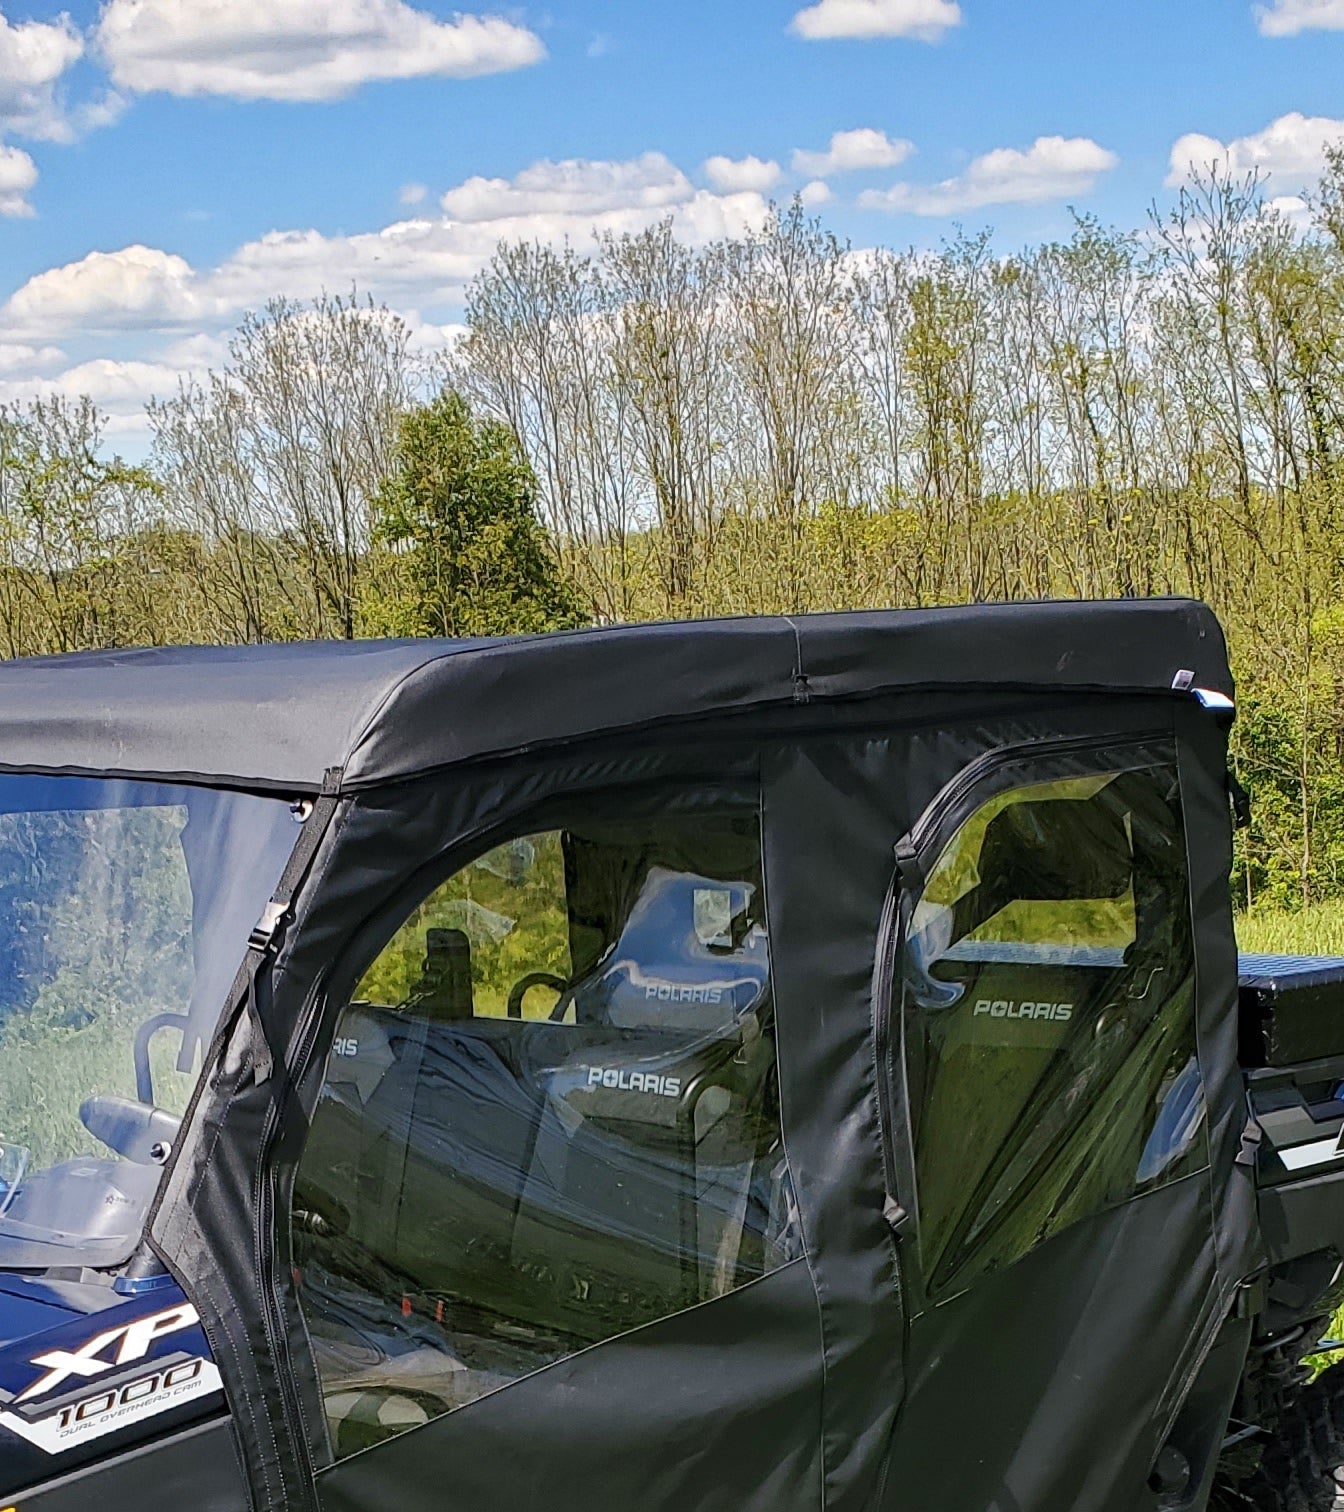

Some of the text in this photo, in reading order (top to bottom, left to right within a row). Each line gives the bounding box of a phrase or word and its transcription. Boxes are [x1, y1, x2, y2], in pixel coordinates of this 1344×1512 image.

[646, 985, 722, 1003] POLARIS
[973, 1000, 1073, 1020] POLARIS
[587, 1067, 681, 1097] POLARIS
[12, 1302, 201, 1404] XP
[58, 1358, 204, 1430] 1000
[59, 1380, 202, 1438] DUAL OVERHEAD CAM
